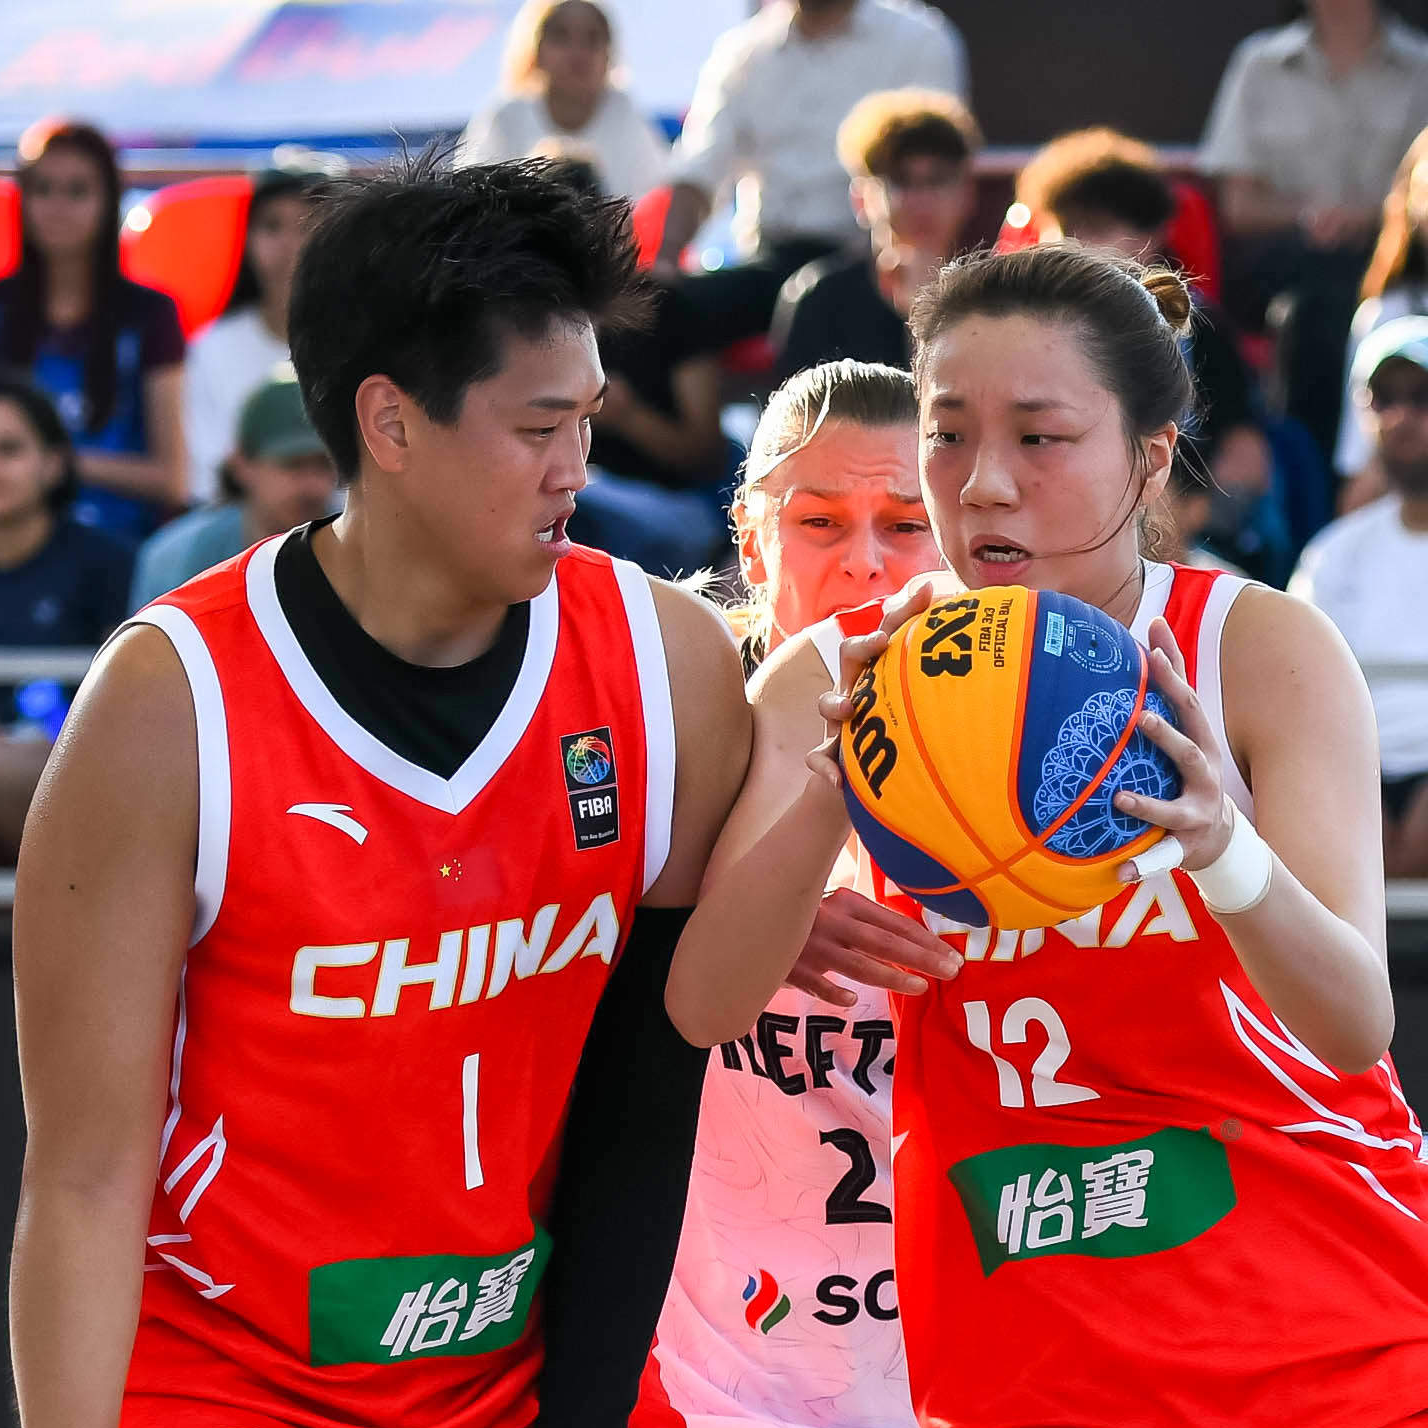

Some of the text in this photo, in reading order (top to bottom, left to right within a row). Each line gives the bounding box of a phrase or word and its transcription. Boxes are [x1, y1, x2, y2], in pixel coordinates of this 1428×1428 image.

[978, 626, 993, 652] FIBA
[993, 598, 1014, 668] OFFICIAL BALL
[578, 795, 613, 819] FIBA
[289, 891, 622, 1019] CHINA
[962, 996, 1101, 1108] 12
[462, 1053, 484, 1191] 1
[818, 1127, 894, 1226] 2
[997, 1149, 1155, 1255] 怡寶
[379, 1248, 536, 1357] 怡寶
